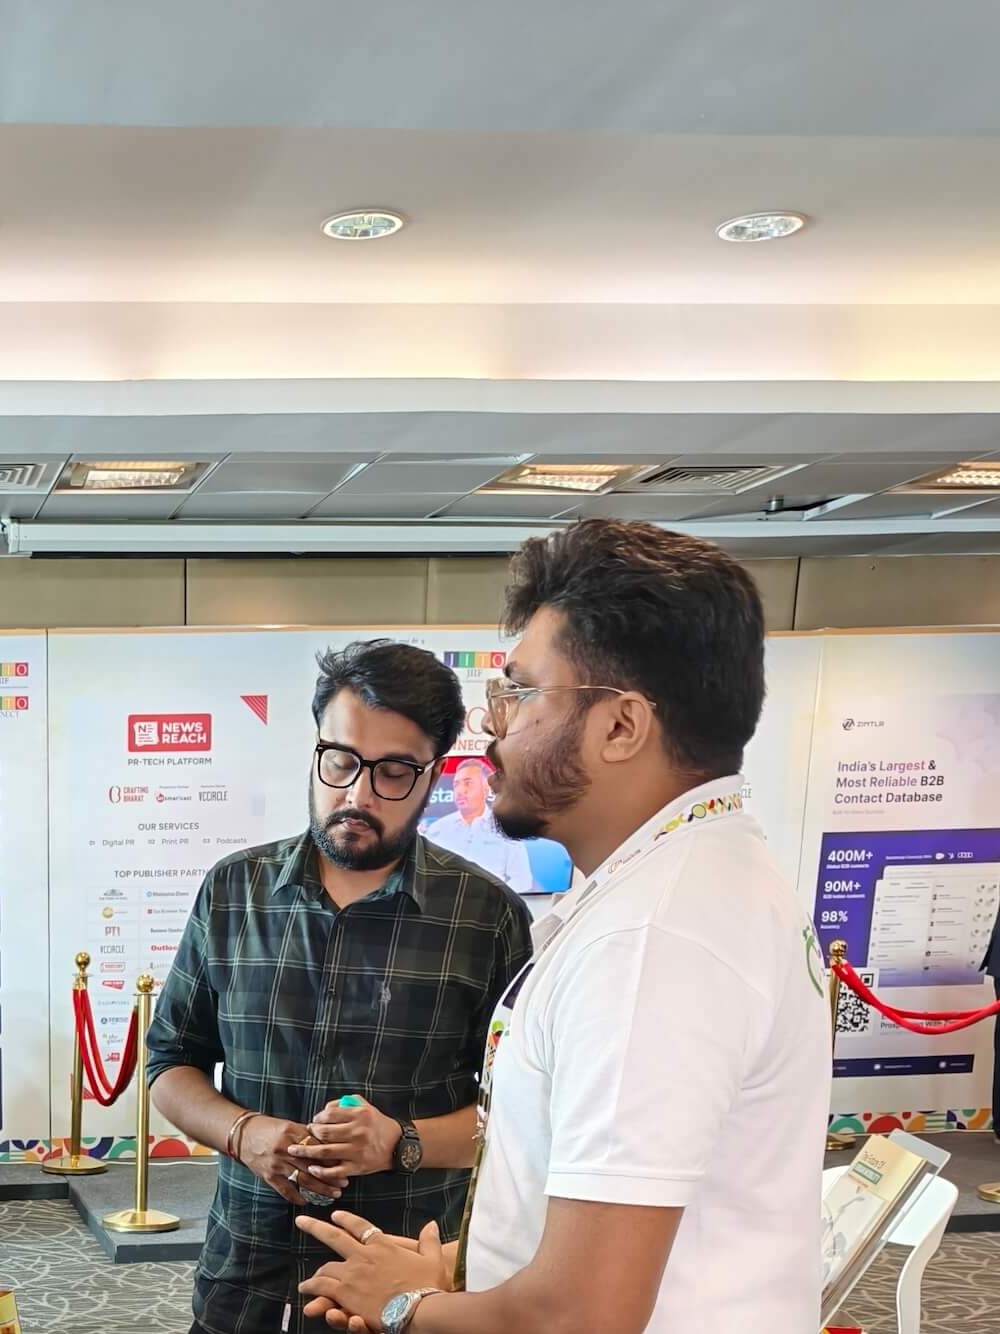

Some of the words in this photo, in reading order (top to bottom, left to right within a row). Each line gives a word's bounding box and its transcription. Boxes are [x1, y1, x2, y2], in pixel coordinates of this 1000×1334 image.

[162, 722, 203, 733] NEWS
[161, 733, 207, 744] REACH
[127, 758, 165, 766] PR-TECH
[166, 757, 212, 766] PLATFORM
[837, 760, 877, 772] India's
[879, 760, 925, 774] Largest
[927, 759, 937, 770] &
[836, 777, 867, 788] Most
[869, 776, 918, 788] Reliable
[920, 775, 945, 786] B2B
[834, 793, 882, 804] Contact
[886, 792, 943, 803] Database
[137, 823, 157, 831] OUR
[158, 822, 200, 831] SERVICES
[102, 839, 124, 847] Digital
[827, 850, 874, 863] 400M+
[114, 870, 132, 878] TOP
[133, 870, 178, 878] PUBLISHER
[180, 869, 208, 877] PARTN
[824, 881, 862, 892] 90M+
[821, 911, 848, 923] 98%
